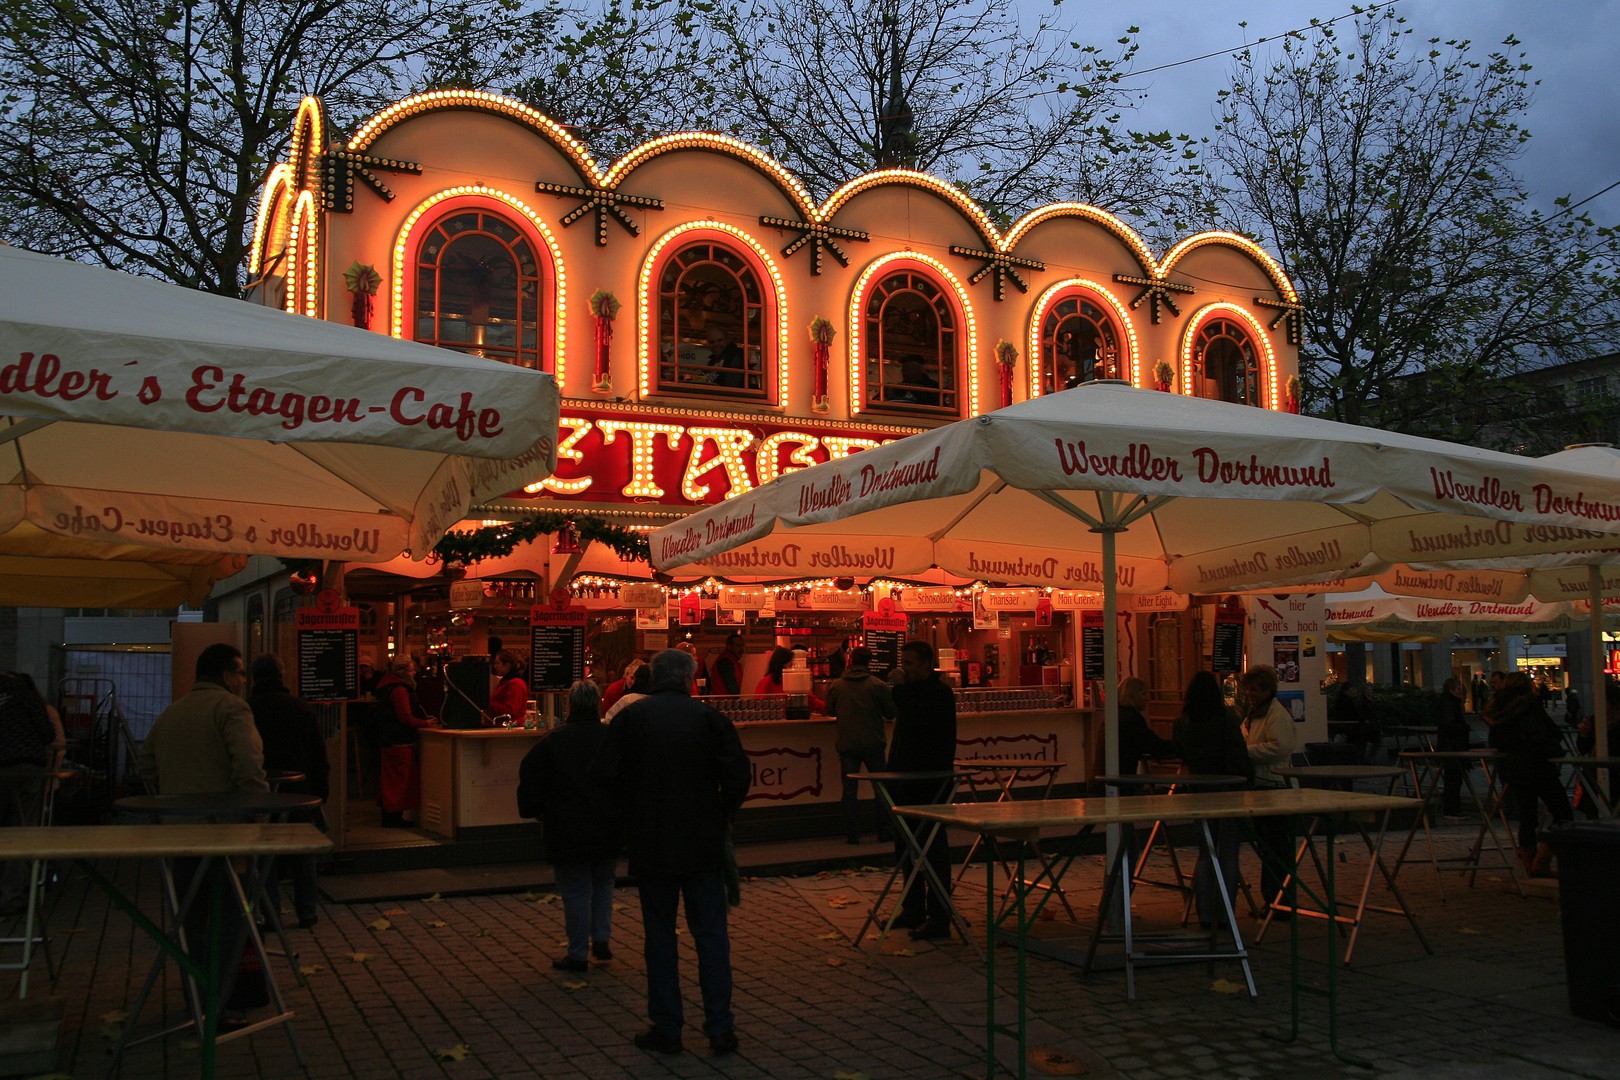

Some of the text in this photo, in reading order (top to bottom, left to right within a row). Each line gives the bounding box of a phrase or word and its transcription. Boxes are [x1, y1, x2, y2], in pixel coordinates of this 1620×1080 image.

[185, 365, 504, 441] Etagen-Cafe
[524, 417, 908, 501] ETAG
[1054, 437, 1336, 489] Wendler Dortmund
[798, 446, 941, 516] Wendler Dortmund
[1430, 466, 1620, 523] Wendler Dortmu
[661, 503, 756, 562] Wendler Dortmund
[917, 592, 954, 605] Schokolade
[1057, 593, 1072, 605] Mon
[1137, 595, 1173, 609] After Eight
[1289, 600, 1306, 611] hier
[1417, 602, 1534, 618] Wendler Dortmund
[1262, 620, 1318, 635] geht's hoch
